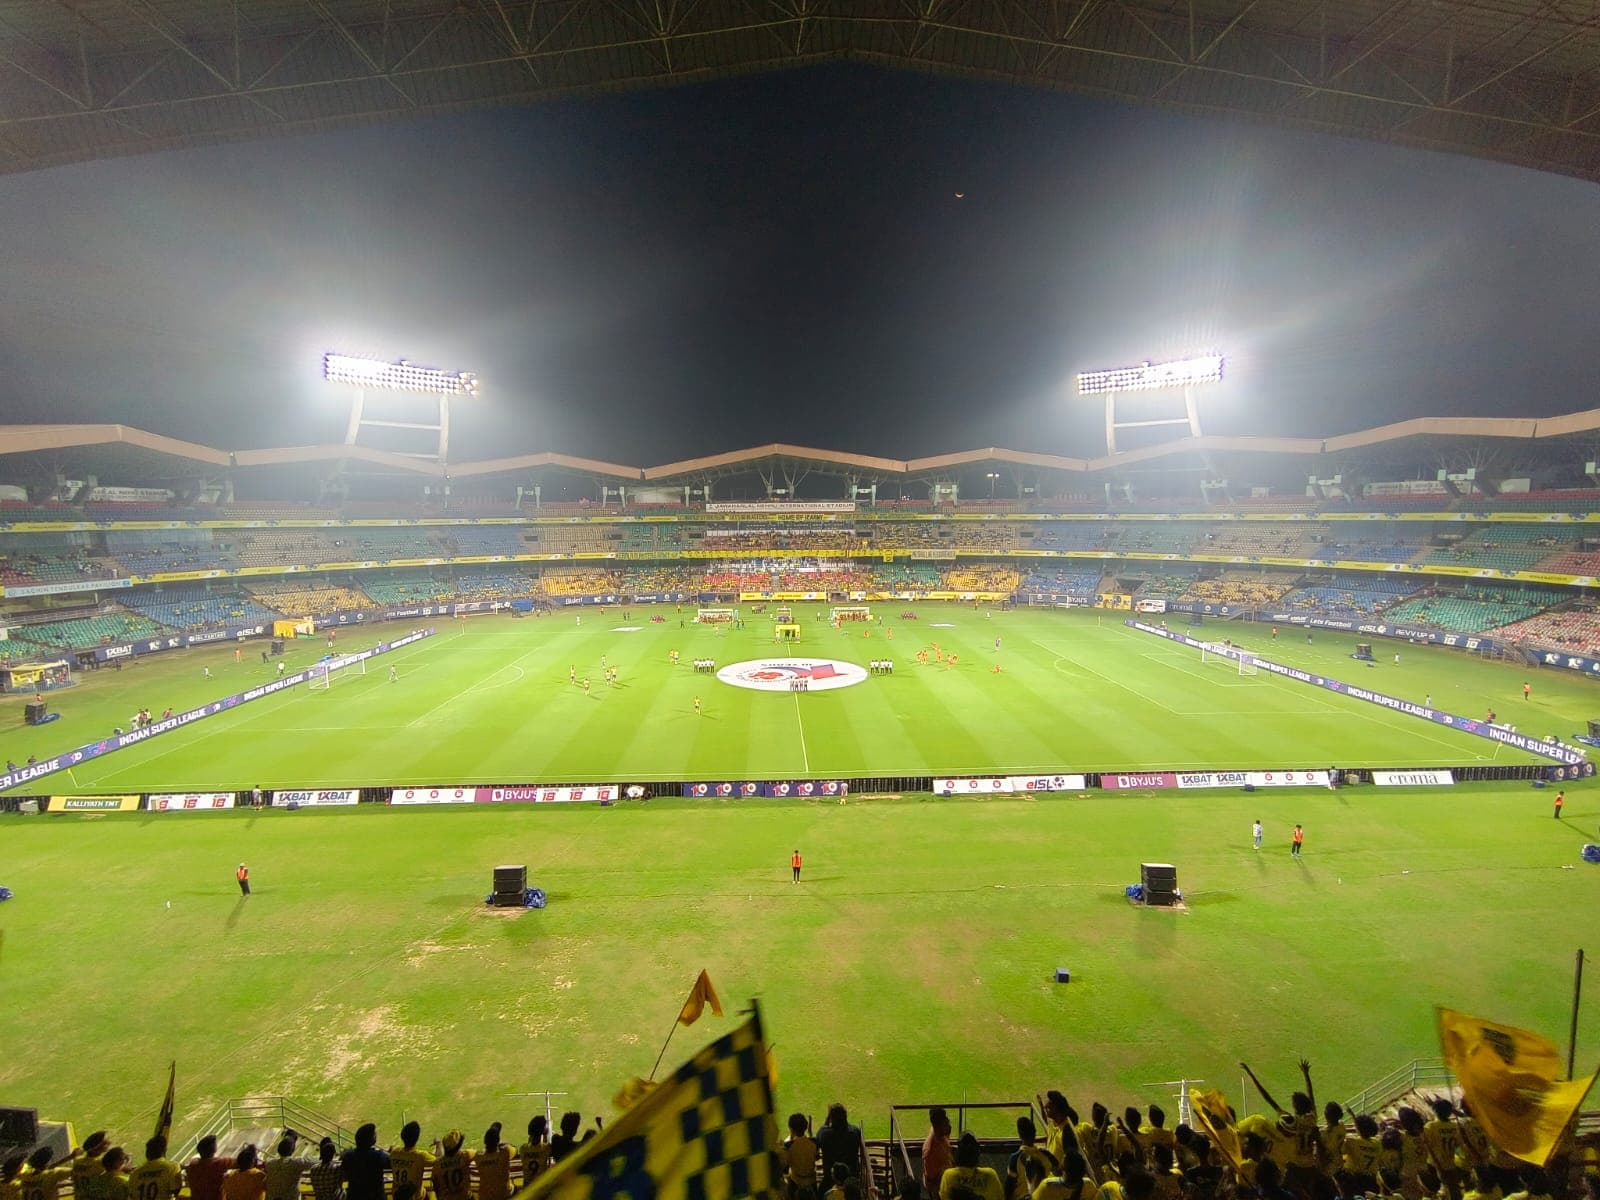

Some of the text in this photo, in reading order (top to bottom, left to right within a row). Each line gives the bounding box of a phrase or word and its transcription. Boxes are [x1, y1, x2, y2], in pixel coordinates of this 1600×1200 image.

[1347, 686, 1434, 720] INDIAN SUPER LEAGUE
[119, 707, 207, 746] INDIAN SUPER LEAGUE
[1489, 728, 1526, 749] INDIAN
[1527, 740, 1563, 761] SUPER
[14, 759, 60, 784] LEAGUE
[1130, 777, 1163, 787] BYJU'S
[1182, 775, 1213, 783] 1XBAT
[1216, 773, 1247, 782] 1XBAT
[1389, 771, 1437, 784] croma
[278, 792, 313, 801] 1XBAT
[317, 791, 352, 800] 1XBAT
